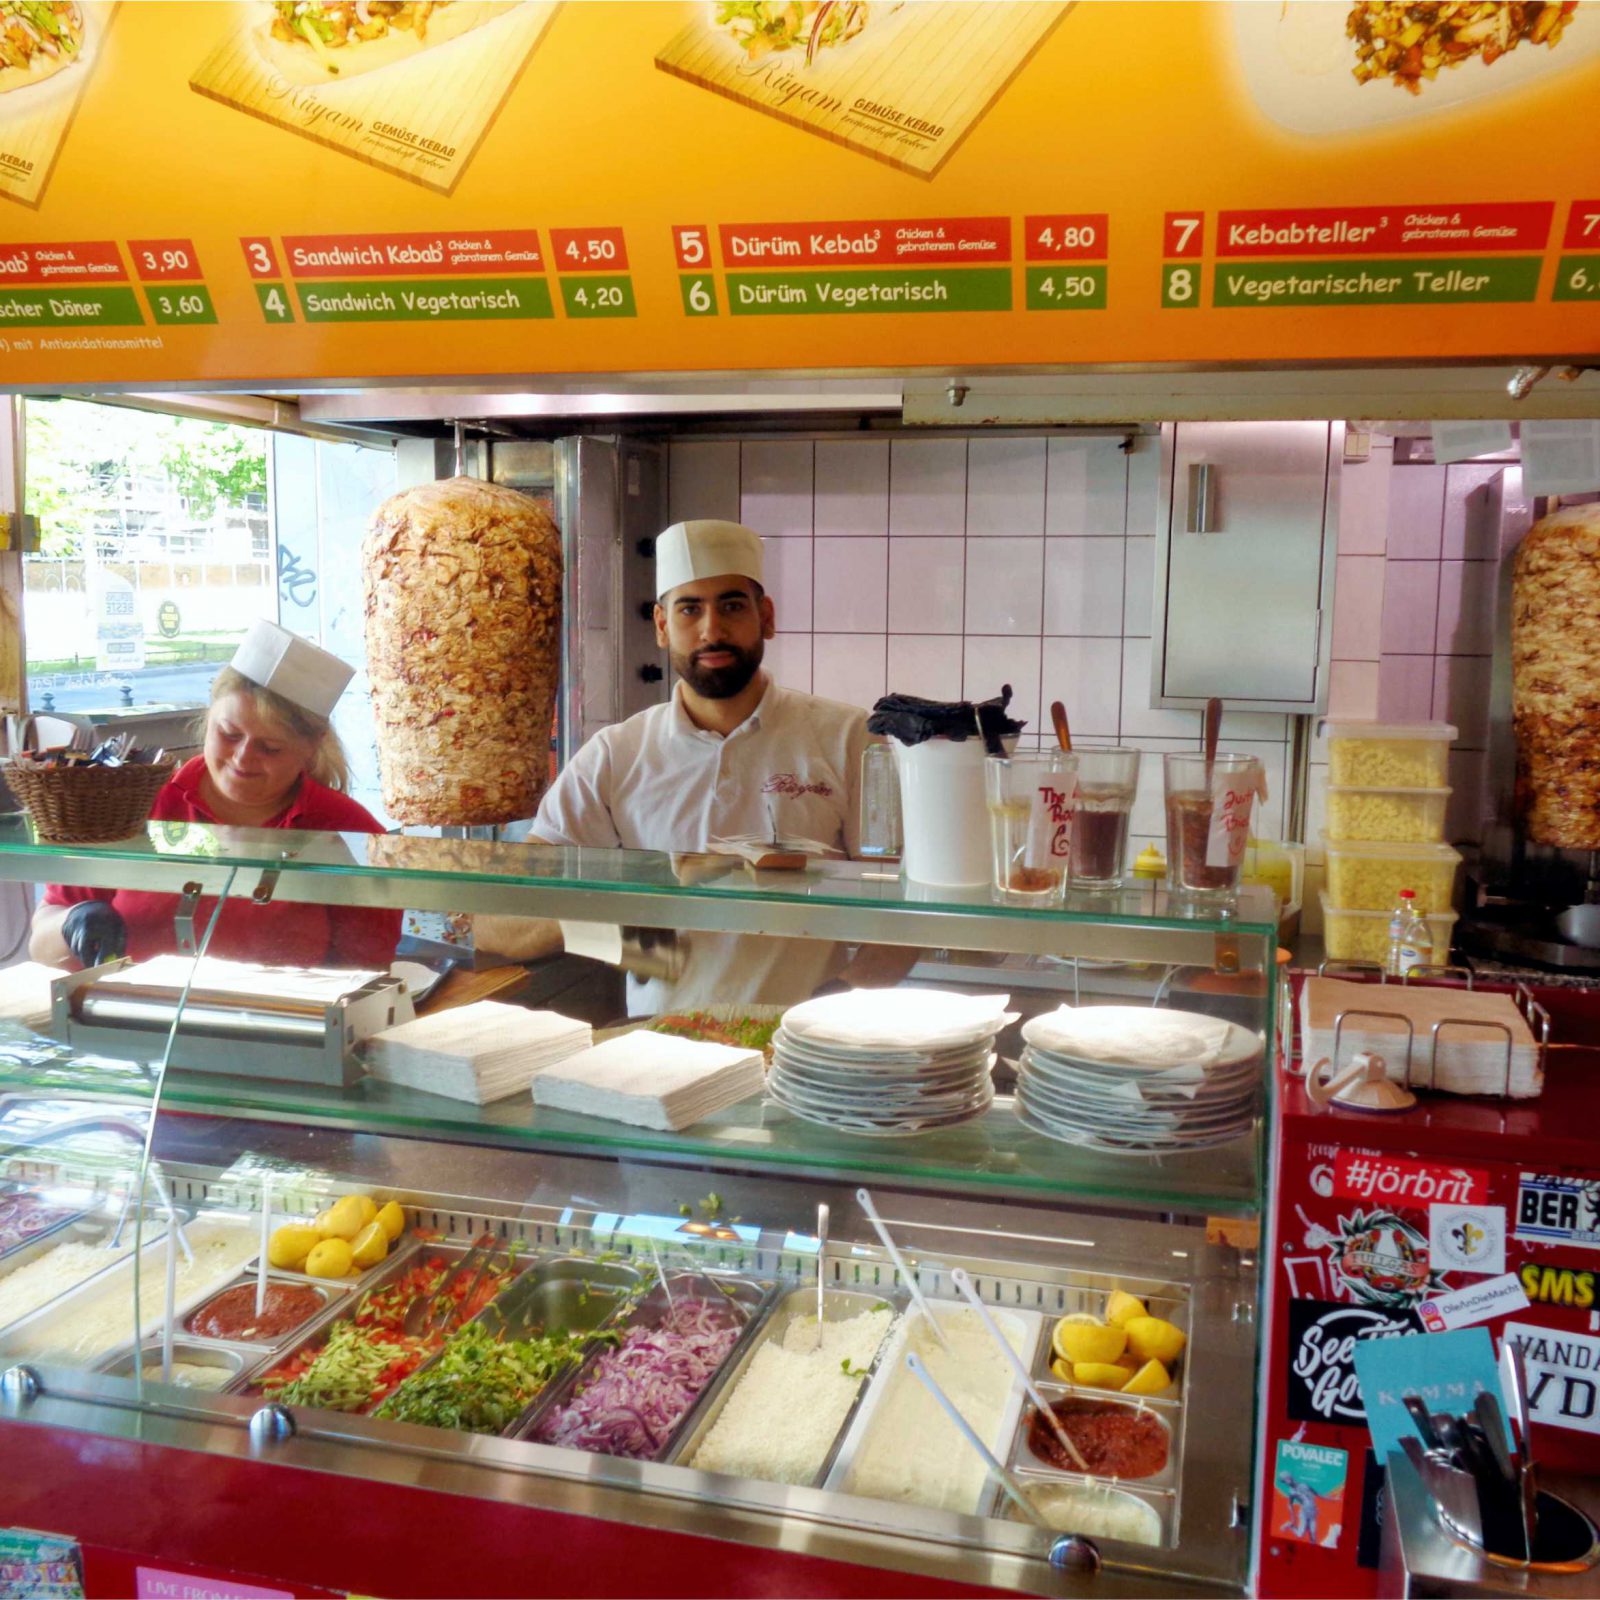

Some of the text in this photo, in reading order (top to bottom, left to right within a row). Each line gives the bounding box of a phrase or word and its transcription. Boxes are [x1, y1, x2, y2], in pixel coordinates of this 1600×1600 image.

[853, 97, 945, 137] GEMÜSE KEBAB
[372, 121, 456, 157] GEMÜSE KEBAB
[0, 152, 34, 171] KEBAB
[1404, 213, 1461, 226] Chicken &
[1472, 224, 1518, 238] Gemüse
[448, 240, 492, 251] Chicken &
[731, 234, 801, 256] Dürüm
[896, 227, 945, 240] Chicken &
[958, 238, 997, 251] Gemüse
[1038, 226, 1096, 250] 4,80
[1172, 219, 1199, 252] 7
[249, 243, 271, 272] 3
[292, 243, 384, 266] Sandwich
[505, 250, 540, 261] Gemüse
[565, 239, 615, 263] 4,50
[682, 230, 705, 263] 5
[142, 250, 189, 273] 3,90
[1039, 276, 1096, 300] 4,50
[1168, 269, 1193, 302] 8
[1228, 271, 1490, 300] Vegetarischer Teller
[1570, 268, 1600, 292] 6,
[158, 296, 204, 316] 3,60
[265, 288, 285, 318] 4
[307, 289, 521, 316] Sandwich Vegetarisch
[574, 287, 623, 310] 4,20
[689, 281, 711, 312] 6
[739, 281, 947, 308] Dürüm Vegetarisch
[49, 299, 102, 318] Döner
[13, 338, 34, 350] mit
[40, 336, 163, 351] Antioxidationsmittel
[1038, 787, 1066, 804] The
[1521, 1264, 1595, 1307] SMS
[1293, 1325, 1357, 1378] See
[1311, 1366, 1364, 1418] Go
[147, 1580, 179, 1595] LIVE
